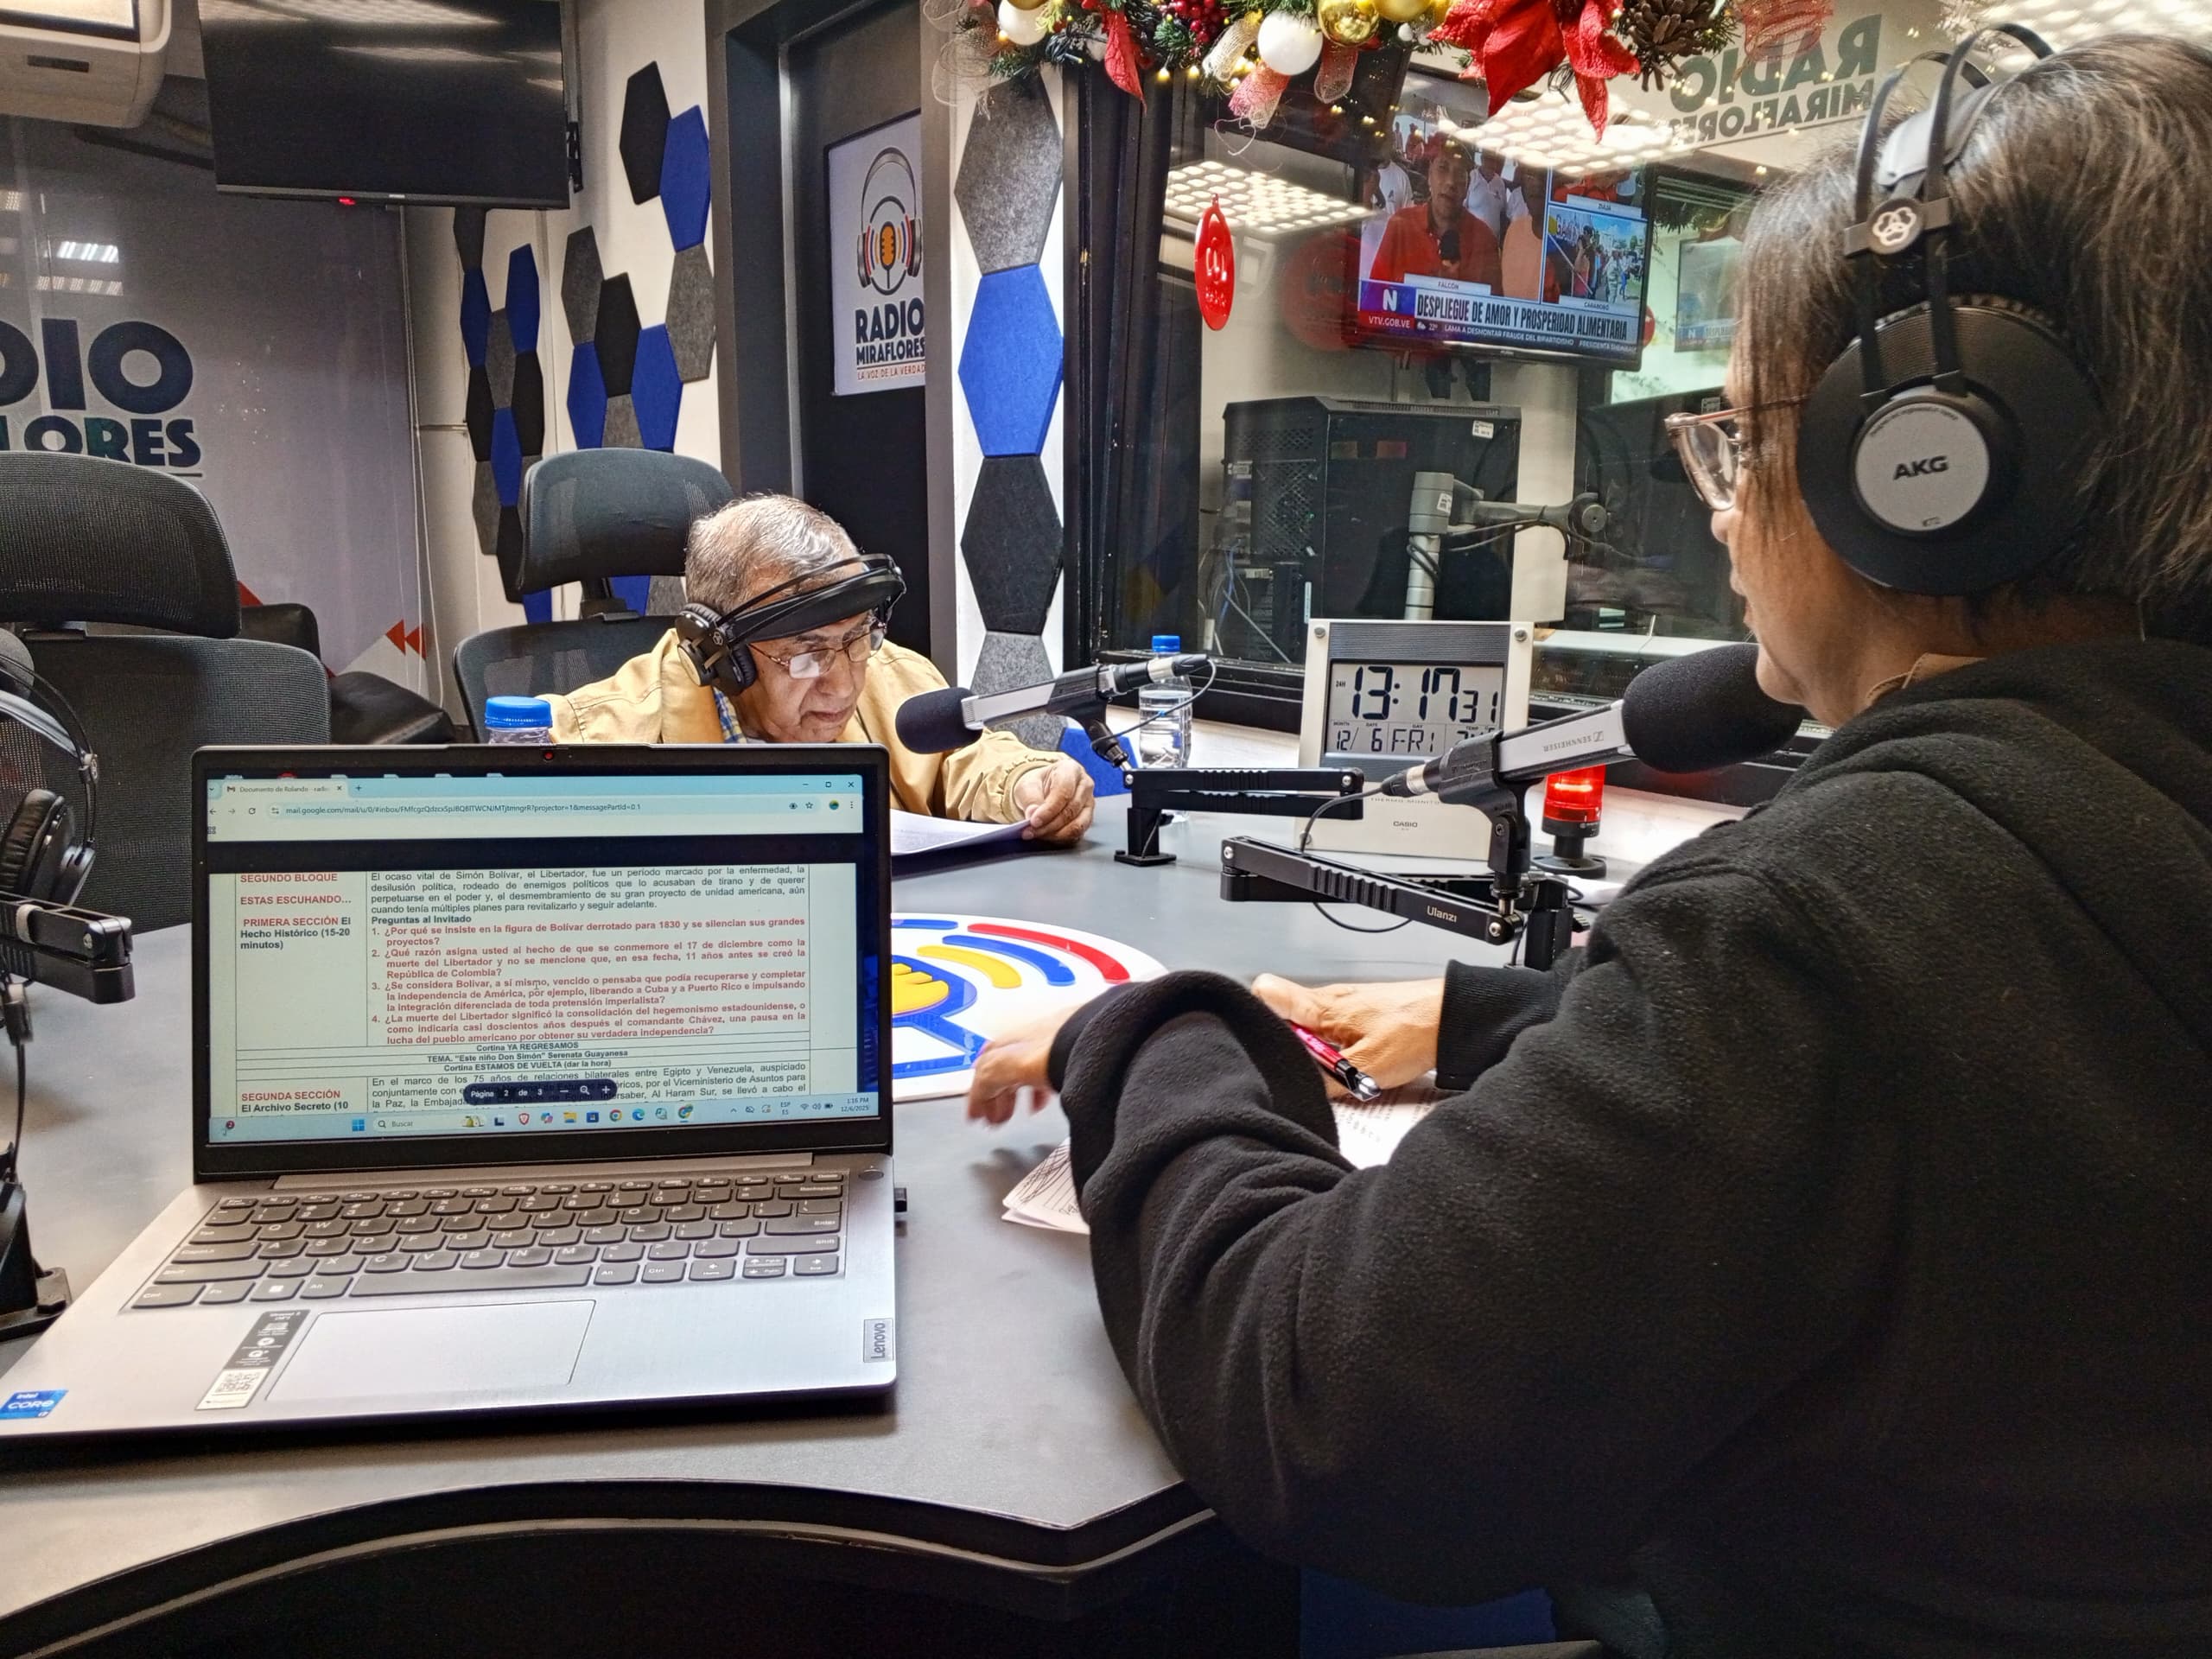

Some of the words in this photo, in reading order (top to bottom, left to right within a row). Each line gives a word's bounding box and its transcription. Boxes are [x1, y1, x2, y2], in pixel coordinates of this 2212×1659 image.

[1382, 289, 1398, 312] N
[855, 297, 925, 344] RADIO
[1369, 315, 1410, 328] VTV.GOB.VE
[1417, 294, 1469, 321] DESPLIEGUE
[1471, 302, 1482, 322] DE
[1486, 304, 1511, 326] AMOR
[1514, 308, 1519, 327] Y
[1521, 308, 1575, 334] PROSPERIDAD
[1577, 315, 1627, 340] ALIMENTARIA
[856, 336, 925, 365] MIRAFLORES
[857, 372, 865, 380] LA
[867, 369, 879, 378] VOZ
[881, 368, 888, 378] DE
[890, 366, 898, 376] LA
[1893, 456, 1949, 480] AKG
[1459, 690, 1498, 724] 31
[1391, 728, 1434, 753] FRI
[371, 872, 380, 880] El
[488, 870, 522, 880] Bolívar,
[540, 869, 587, 878] Libertador,
[626, 868, 660, 877] período
[739, 866, 792, 874] enfermedad,
[240, 896, 273, 905] ESTAS
[371, 905, 404, 913] cuando
[431, 904, 470, 913] múltiples
[473, 903, 502, 912] planes
[527, 901, 577, 910] revitalizarlo
[587, 900, 614, 911] seguir
[292, 916, 338, 925] SECCIÓN
[371, 916, 420, 925] Preguntas
[1427, 906, 1457, 922] Ulanzi
[321, 928, 350, 938] (15-20
[384, 926, 408, 937] ¿Por
[410, 926, 428, 936] qué
[505, 924, 532, 933] figura
[705, 918, 746, 927] silencian
[768, 918, 804, 927] grandes
[240, 940, 283, 950] minutos)
[386, 937, 440, 947] proyectos?
[386, 969, 434, 980] República
[450, 968, 501, 976] Colombia?
[241, 1092, 292, 1101] SEGUNDA
[294, 1089, 340, 1099] SECCIÓN
[252, 1103, 291, 1111] Archivo
[294, 1102, 331, 1110] Secreto
[334, 1101, 348, 1110] (10
[871, 1323, 886, 1358] Lenovo
